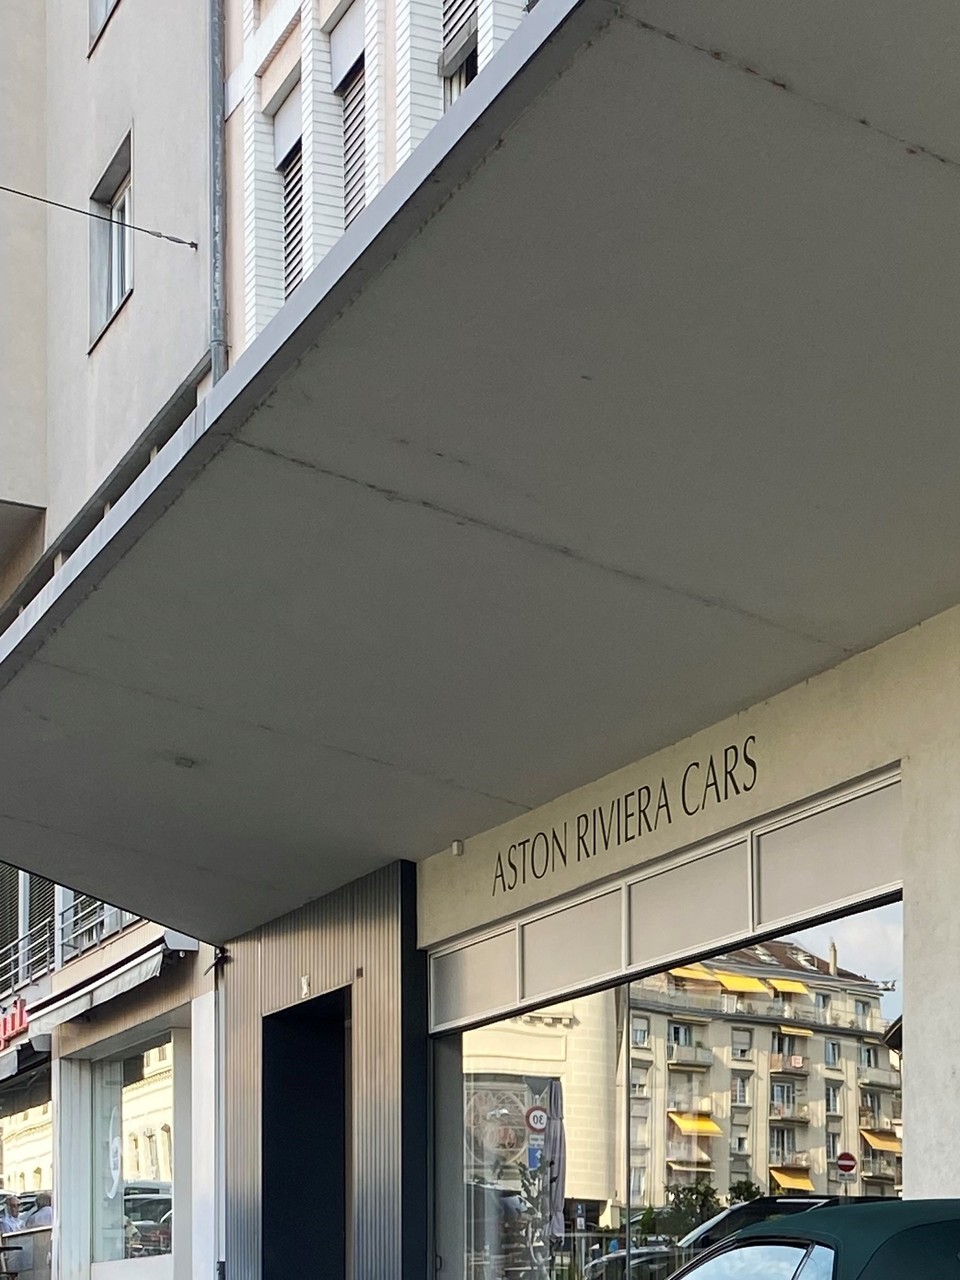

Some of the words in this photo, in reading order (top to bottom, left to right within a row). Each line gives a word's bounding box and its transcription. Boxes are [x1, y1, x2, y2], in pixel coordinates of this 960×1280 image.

[492, 821, 568, 897] ASTON
[577, 777, 673, 862] RIVIERA
[681, 735, 757, 816] CARS
